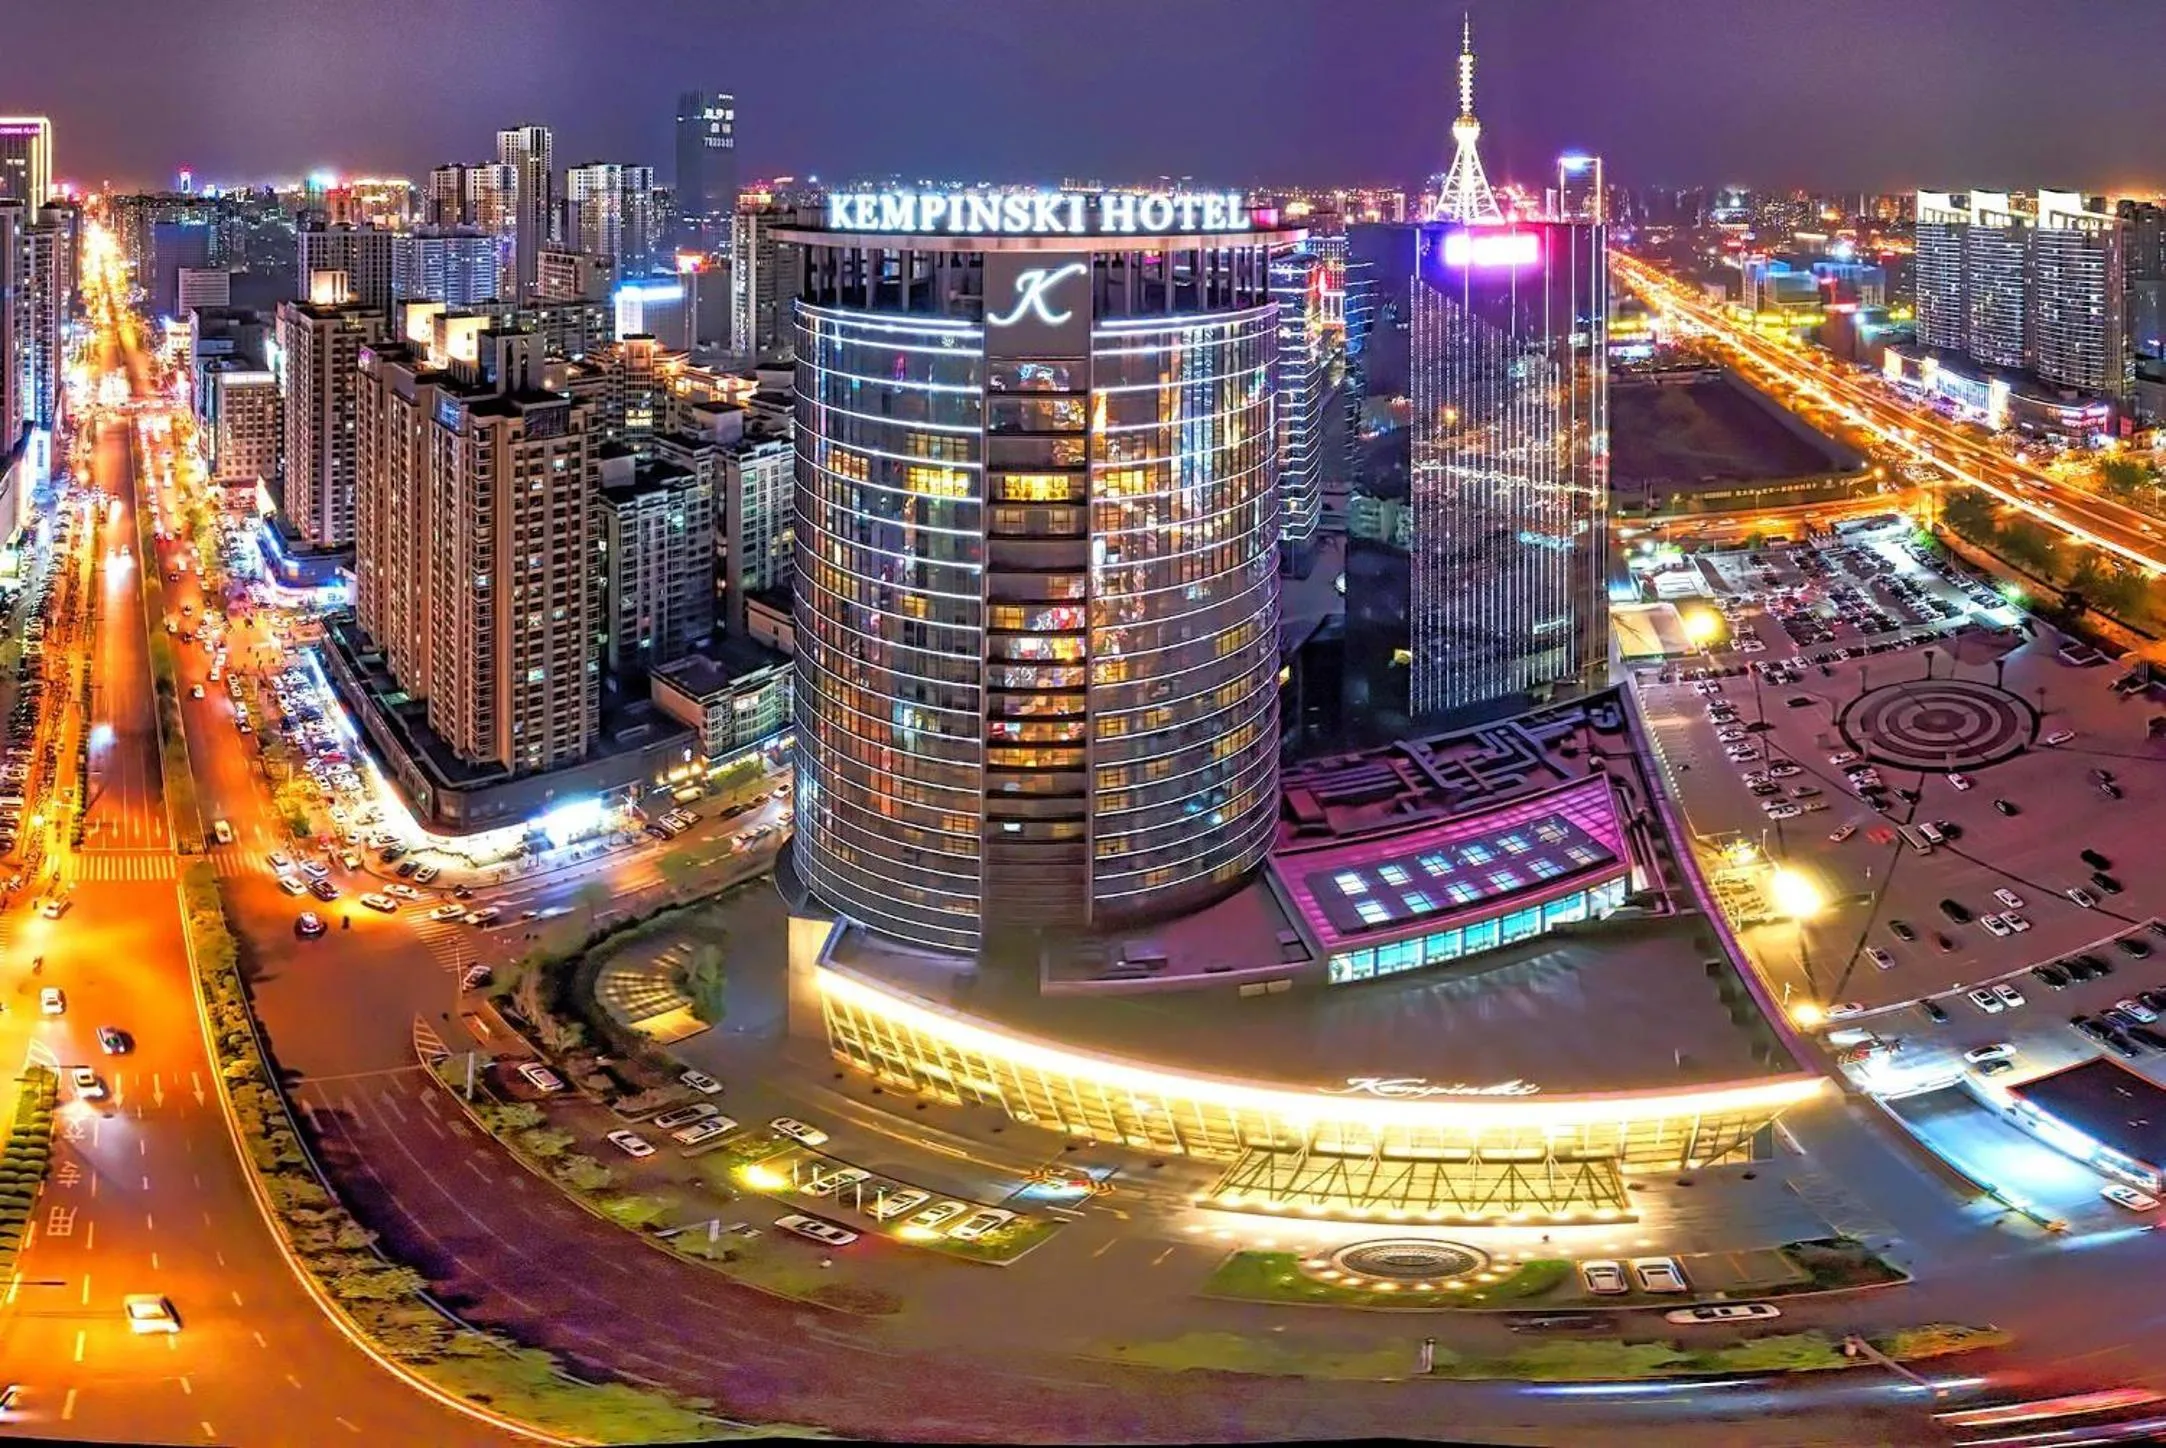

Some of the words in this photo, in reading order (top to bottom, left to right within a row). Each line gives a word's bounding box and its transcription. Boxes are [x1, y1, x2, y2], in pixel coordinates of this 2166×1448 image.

[828, 193, 1085, 233] KEMPINSKI
[1099, 194, 1250, 232] HOTEL
[986, 263, 1088, 327] K
